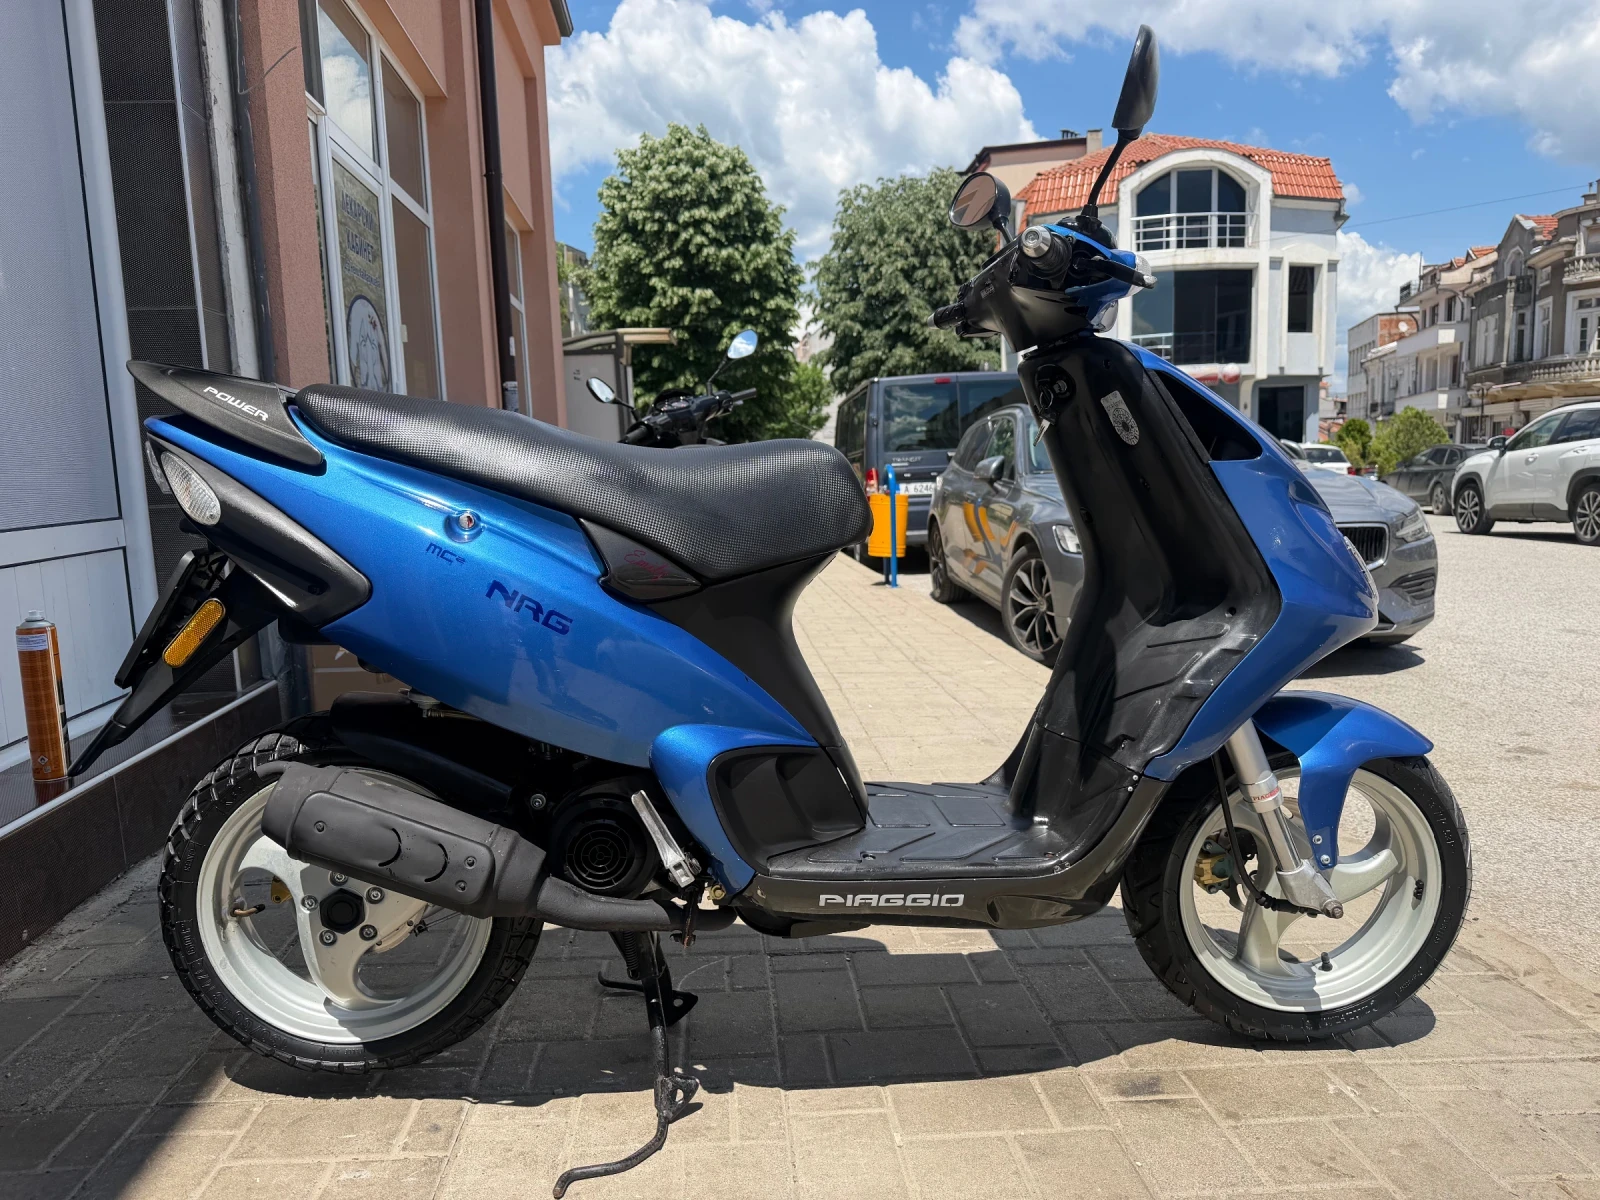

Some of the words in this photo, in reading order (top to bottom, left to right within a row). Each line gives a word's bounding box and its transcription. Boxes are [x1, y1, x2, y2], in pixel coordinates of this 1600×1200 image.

[341, 189, 375, 232] ЛЕКАРСКИ
[345, 226, 374, 264] КАБИНЕТ
[203, 386, 269, 421] POWER
[904, 485, 909, 493] A
[914, 484, 934, 493] 6246
[485, 579, 574, 636] NRG
[818, 893, 965, 907] PIAGGIO
